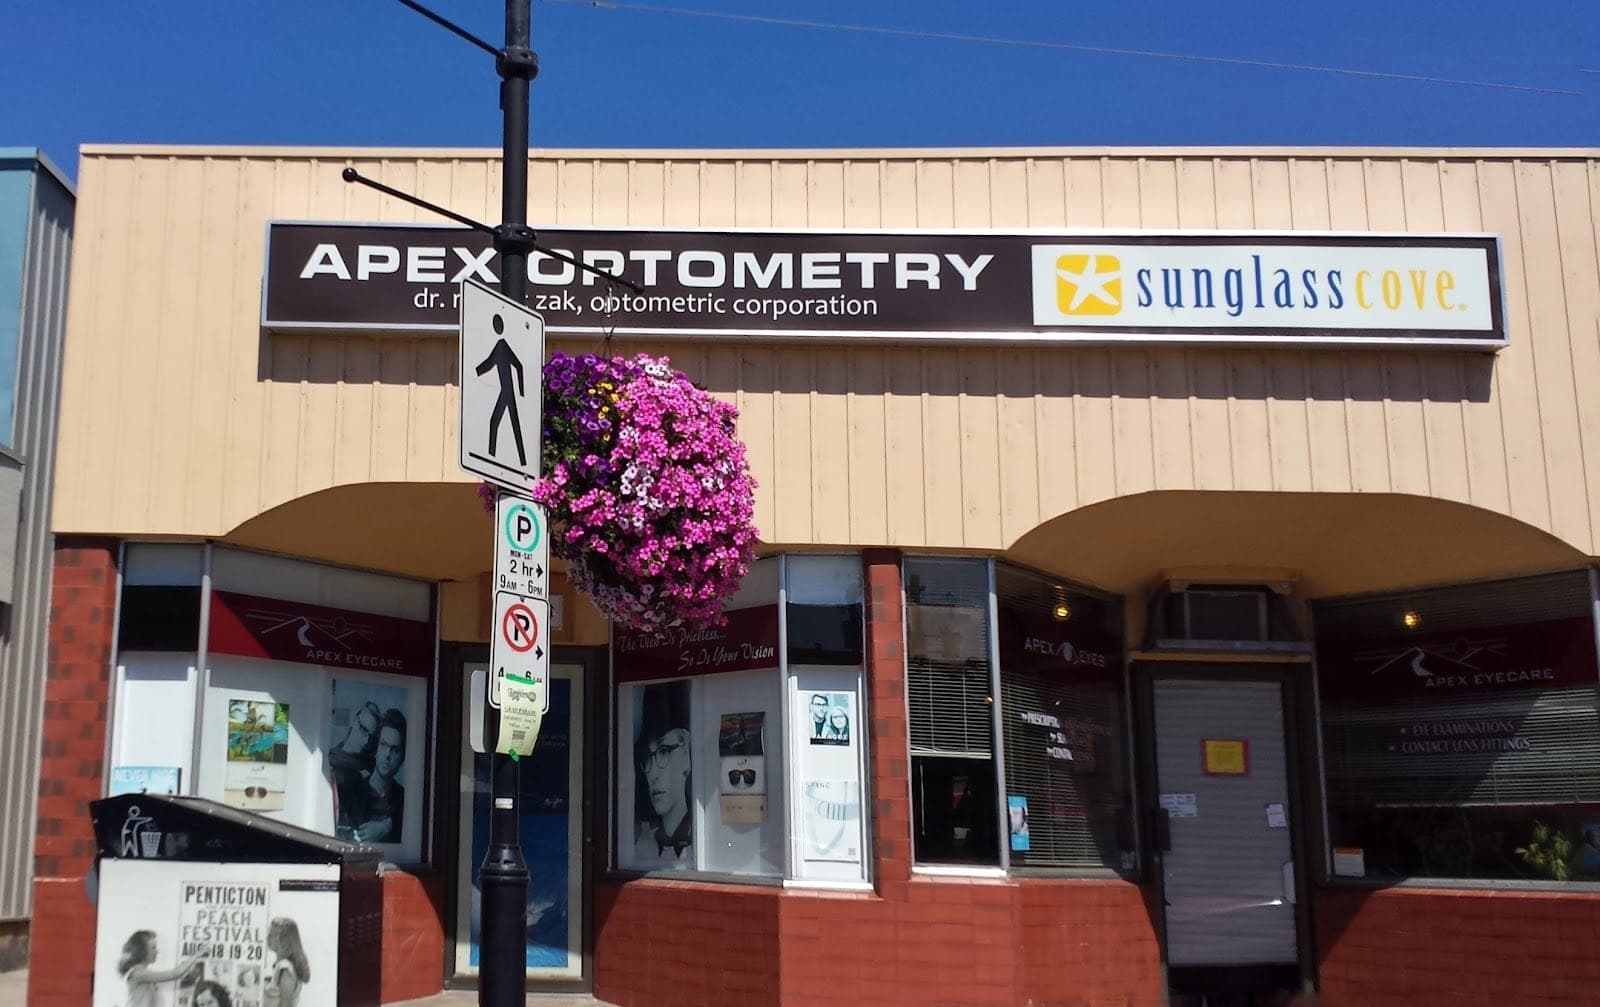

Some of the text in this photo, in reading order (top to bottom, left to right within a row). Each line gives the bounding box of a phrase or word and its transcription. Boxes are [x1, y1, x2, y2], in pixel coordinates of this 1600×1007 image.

[299, 243, 995, 291] APEX OPTOMETRY
[414, 288, 445, 308] dr.
[536, 292, 583, 316] zak,
[590, 292, 725, 317] optometric
[733, 295, 878, 320] corporation
[516, 515, 532, 542] P
[510, 559, 534, 577] 2 hr
[500, 574, 517, 590] 9AM
[528, 580, 543, 595] 6PM
[306, 649, 404, 669] APEX EYECARE
[678, 643, 774, 672] So Is Your Vision
[1024, 635, 1105, 668] APEX EYES
[1425, 668, 1555, 688] APEX EYECARE
[1413, 720, 1515, 736] EYE EXAMINATIONS
[1401, 736, 1531, 752] CONTACT LENS FITTINGS
[185, 885, 266, 906] PENTICTON
[197, 910, 251, 926] PEACH
[183, 926, 264, 943] FESTIVAL
[212, 943, 224, 959] 18
[229, 944, 242, 959] 19
[247, 945, 263, 960] 20
